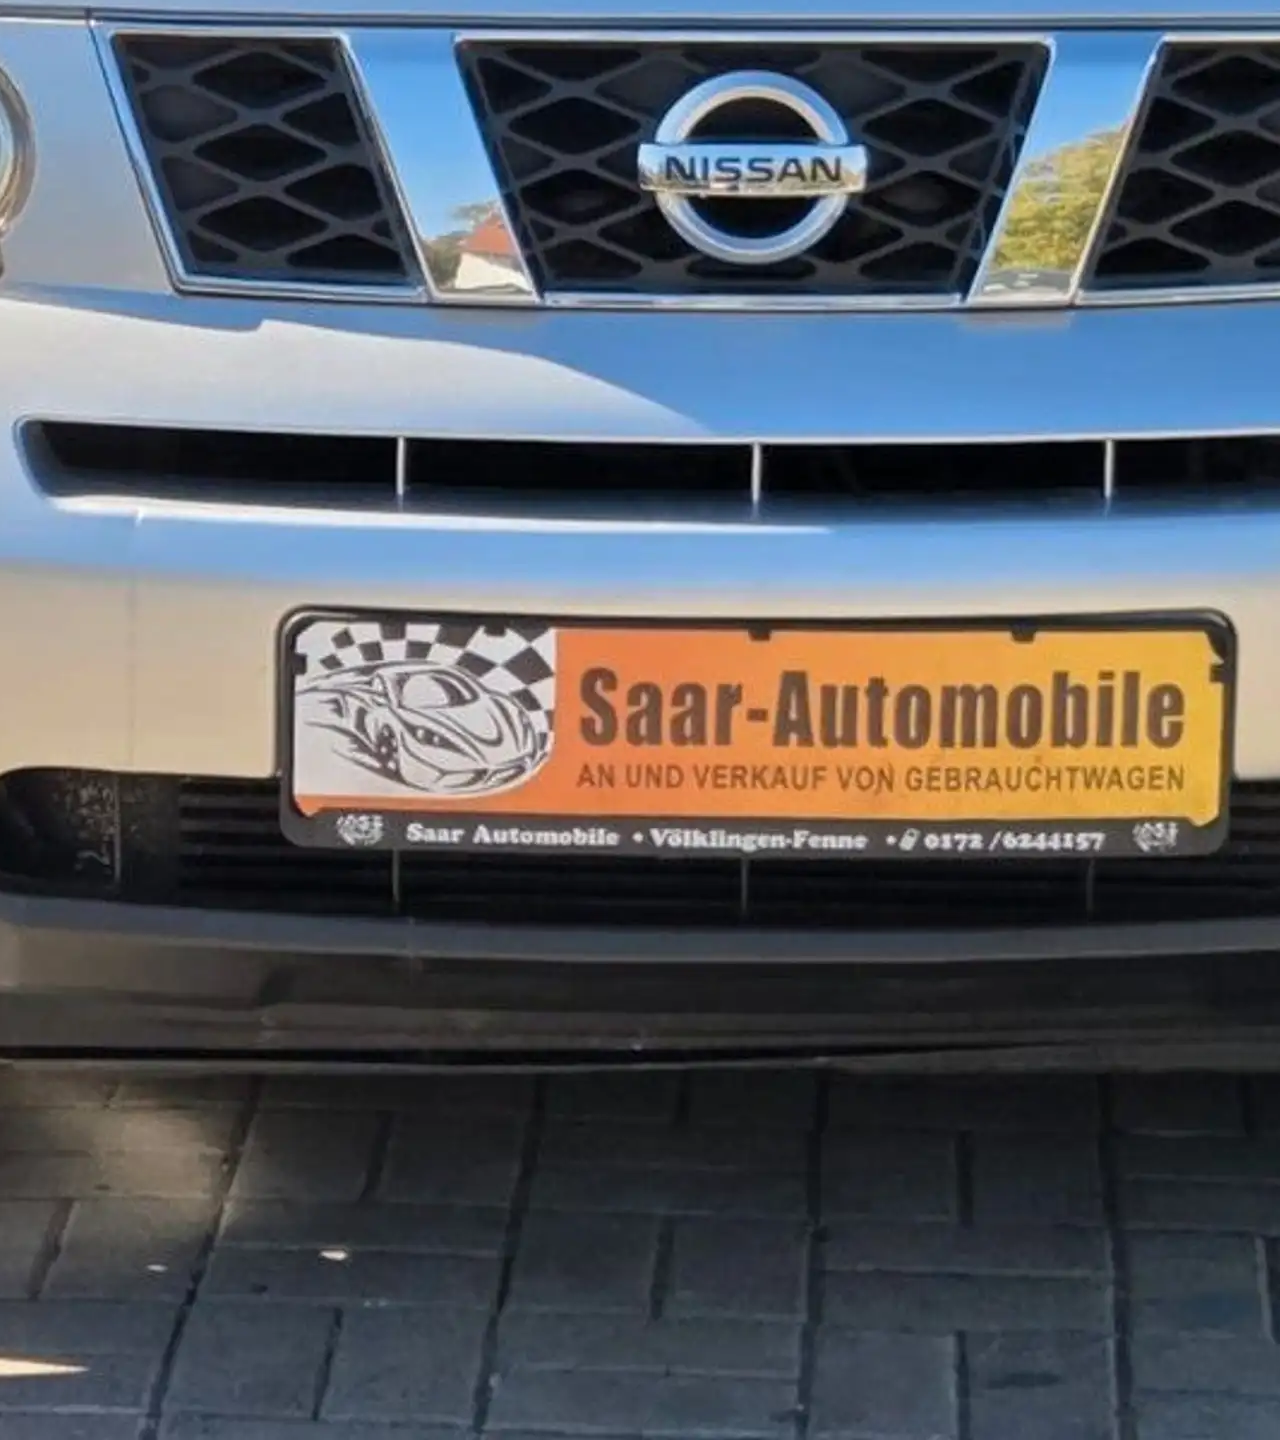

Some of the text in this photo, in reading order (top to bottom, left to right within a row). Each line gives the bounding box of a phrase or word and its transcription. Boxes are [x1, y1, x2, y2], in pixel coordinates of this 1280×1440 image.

[665, 155, 842, 183] NISSAN
[578, 666, 1186, 750] Saar-Automobile
[576, 763, 1185, 792] AN UND VERKAUF VON GEBRAUCHTWAGEN
[406, 823, 464, 844] Saar
[472, 824, 619, 846] Automobile
[649, 826, 868, 851] Völklingen-Fenne
[924, 831, 982, 851] 0172
